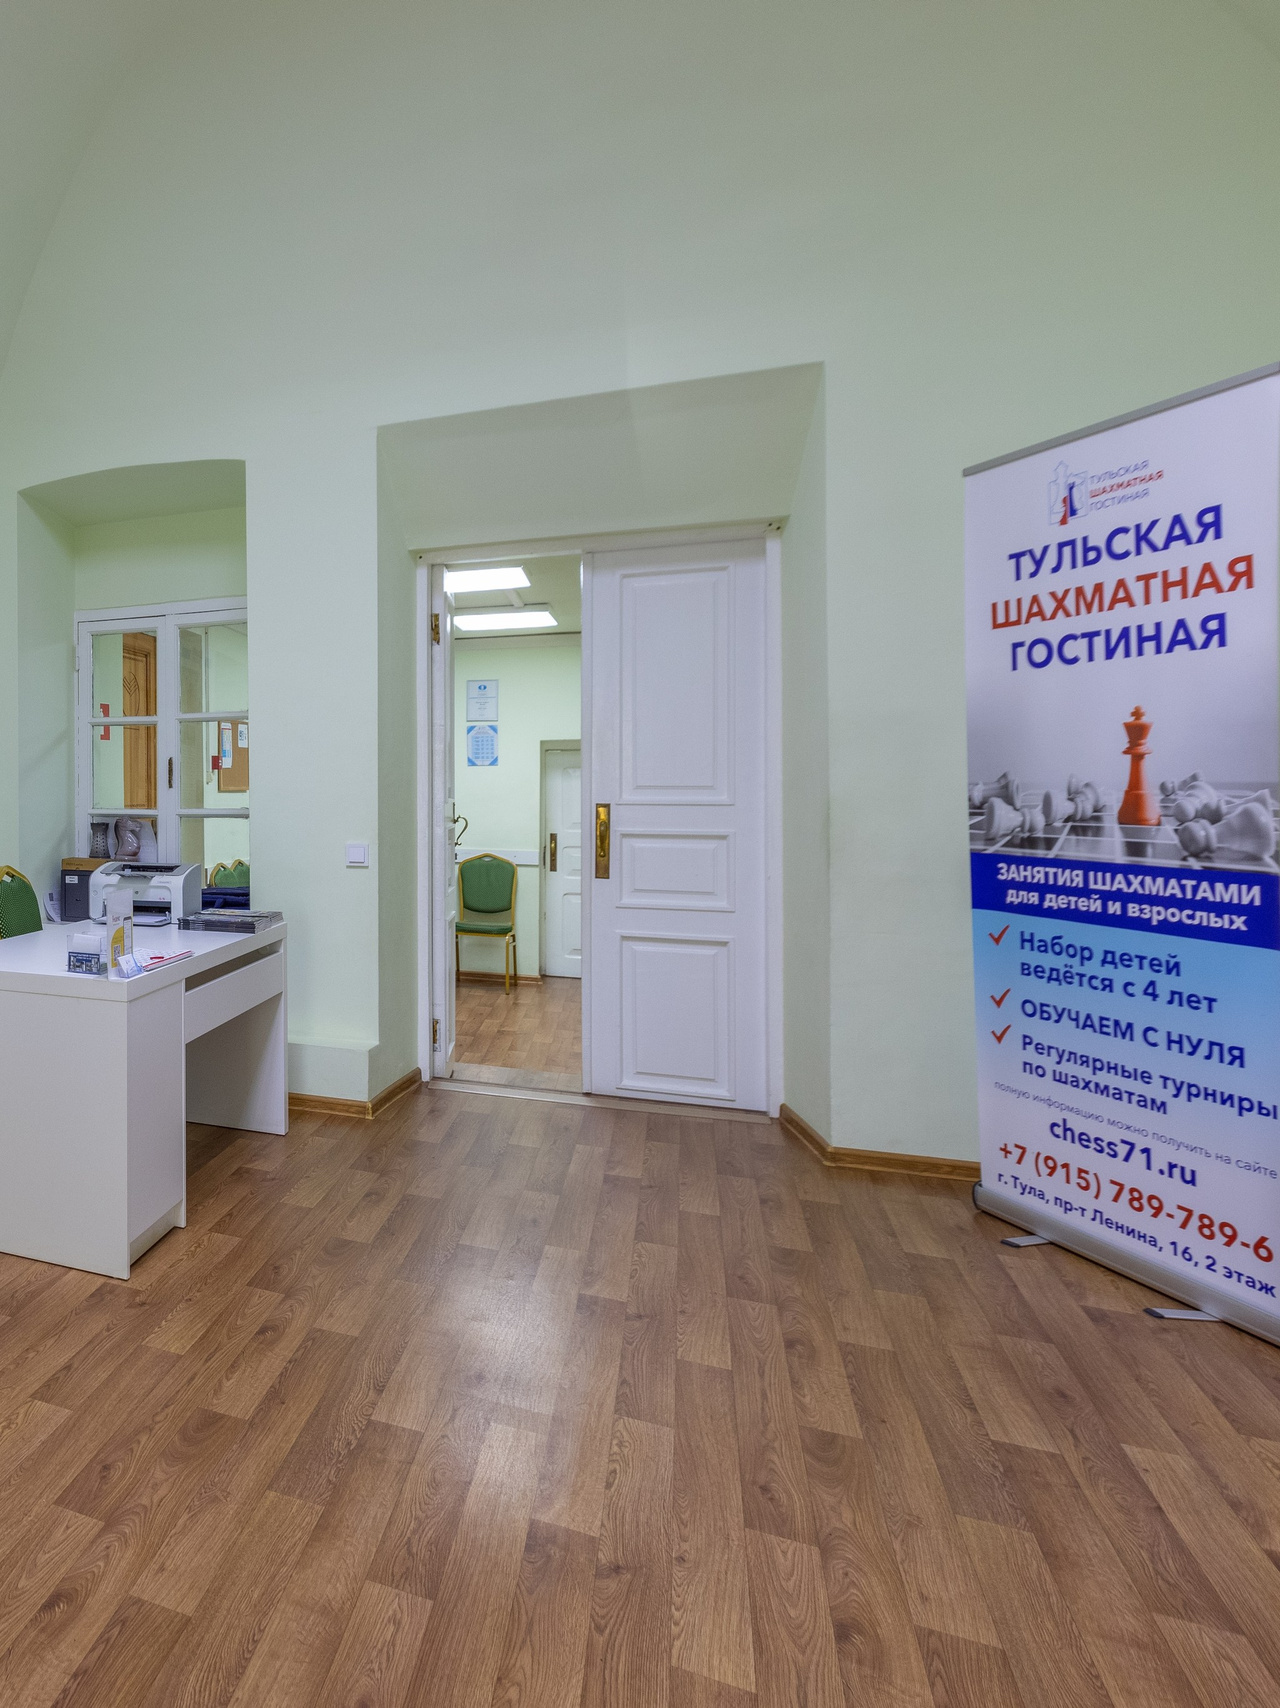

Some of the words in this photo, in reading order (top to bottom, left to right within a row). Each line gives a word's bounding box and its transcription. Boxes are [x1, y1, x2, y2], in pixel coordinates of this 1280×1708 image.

[1008, 503, 1223, 582] ТУЛЬСКАЯ
[991, 554, 1254, 630] ШАХМАТНАЯ
[1010, 612, 1227, 672] ГОСТИНАЯ
[996, 862, 1083, 887] ЗАНЯТИЯ
[1088, 871, 1261, 906] ШАХМАТАМИ
[1006, 889, 1039, 905] для
[1043, 892, 1102, 914] детей
[1107, 900, 1121, 915] и
[1127, 902, 1248, 931] взрослых
[1019, 930, 1094, 966] Набор
[1100, 947, 1181, 977] детей
[1020, 961, 1114, 993] ведётся
[1123, 980, 1136, 997] с
[1142, 980, 1160, 1002] 4
[1167, 990, 1218, 1014] лет
[1021, 999, 1135, 1042] ОБУЧАЕМ
[1142, 1026, 1160, 1048] С
[1166, 1030, 1246, 1069] НУЛЯ
[1022, 1034, 1153, 1085] Регулярные
[1159, 1074, 1278, 1120] турниры
[1023, 1061, 1046, 1078] по
[1052, 1068, 1167, 1115] шахматам
[994, 1080, 1030, 1101] полную
[1032, 1094, 1104, 1125] информацию
[1107, 1117, 1149, 1138] можно
[1151, 1131, 1212, 1159] получить
[1215, 1151, 1232, 1165] на
[1235, 1157, 1278, 1180] сайте
[1049, 1117, 1198, 1188] chess71.ru
[998, 1172, 1008, 1187] г.
[1011, 1175, 1050, 1205] Тула,
[1054, 1194, 1087, 1218] пр-т
[1090, 1209, 1164, 1252] Ленина,
[1169, 1240, 1199, 1268] 16,
[1204, 1255, 1217, 1273] 2
[1222, 1267, 1277, 1298] этаж
[999, 1142, 1027, 1166] +7
[1034, 1151, 1101, 1200] (915)
[1109, 1179, 1274, 1263] 789-789-6
